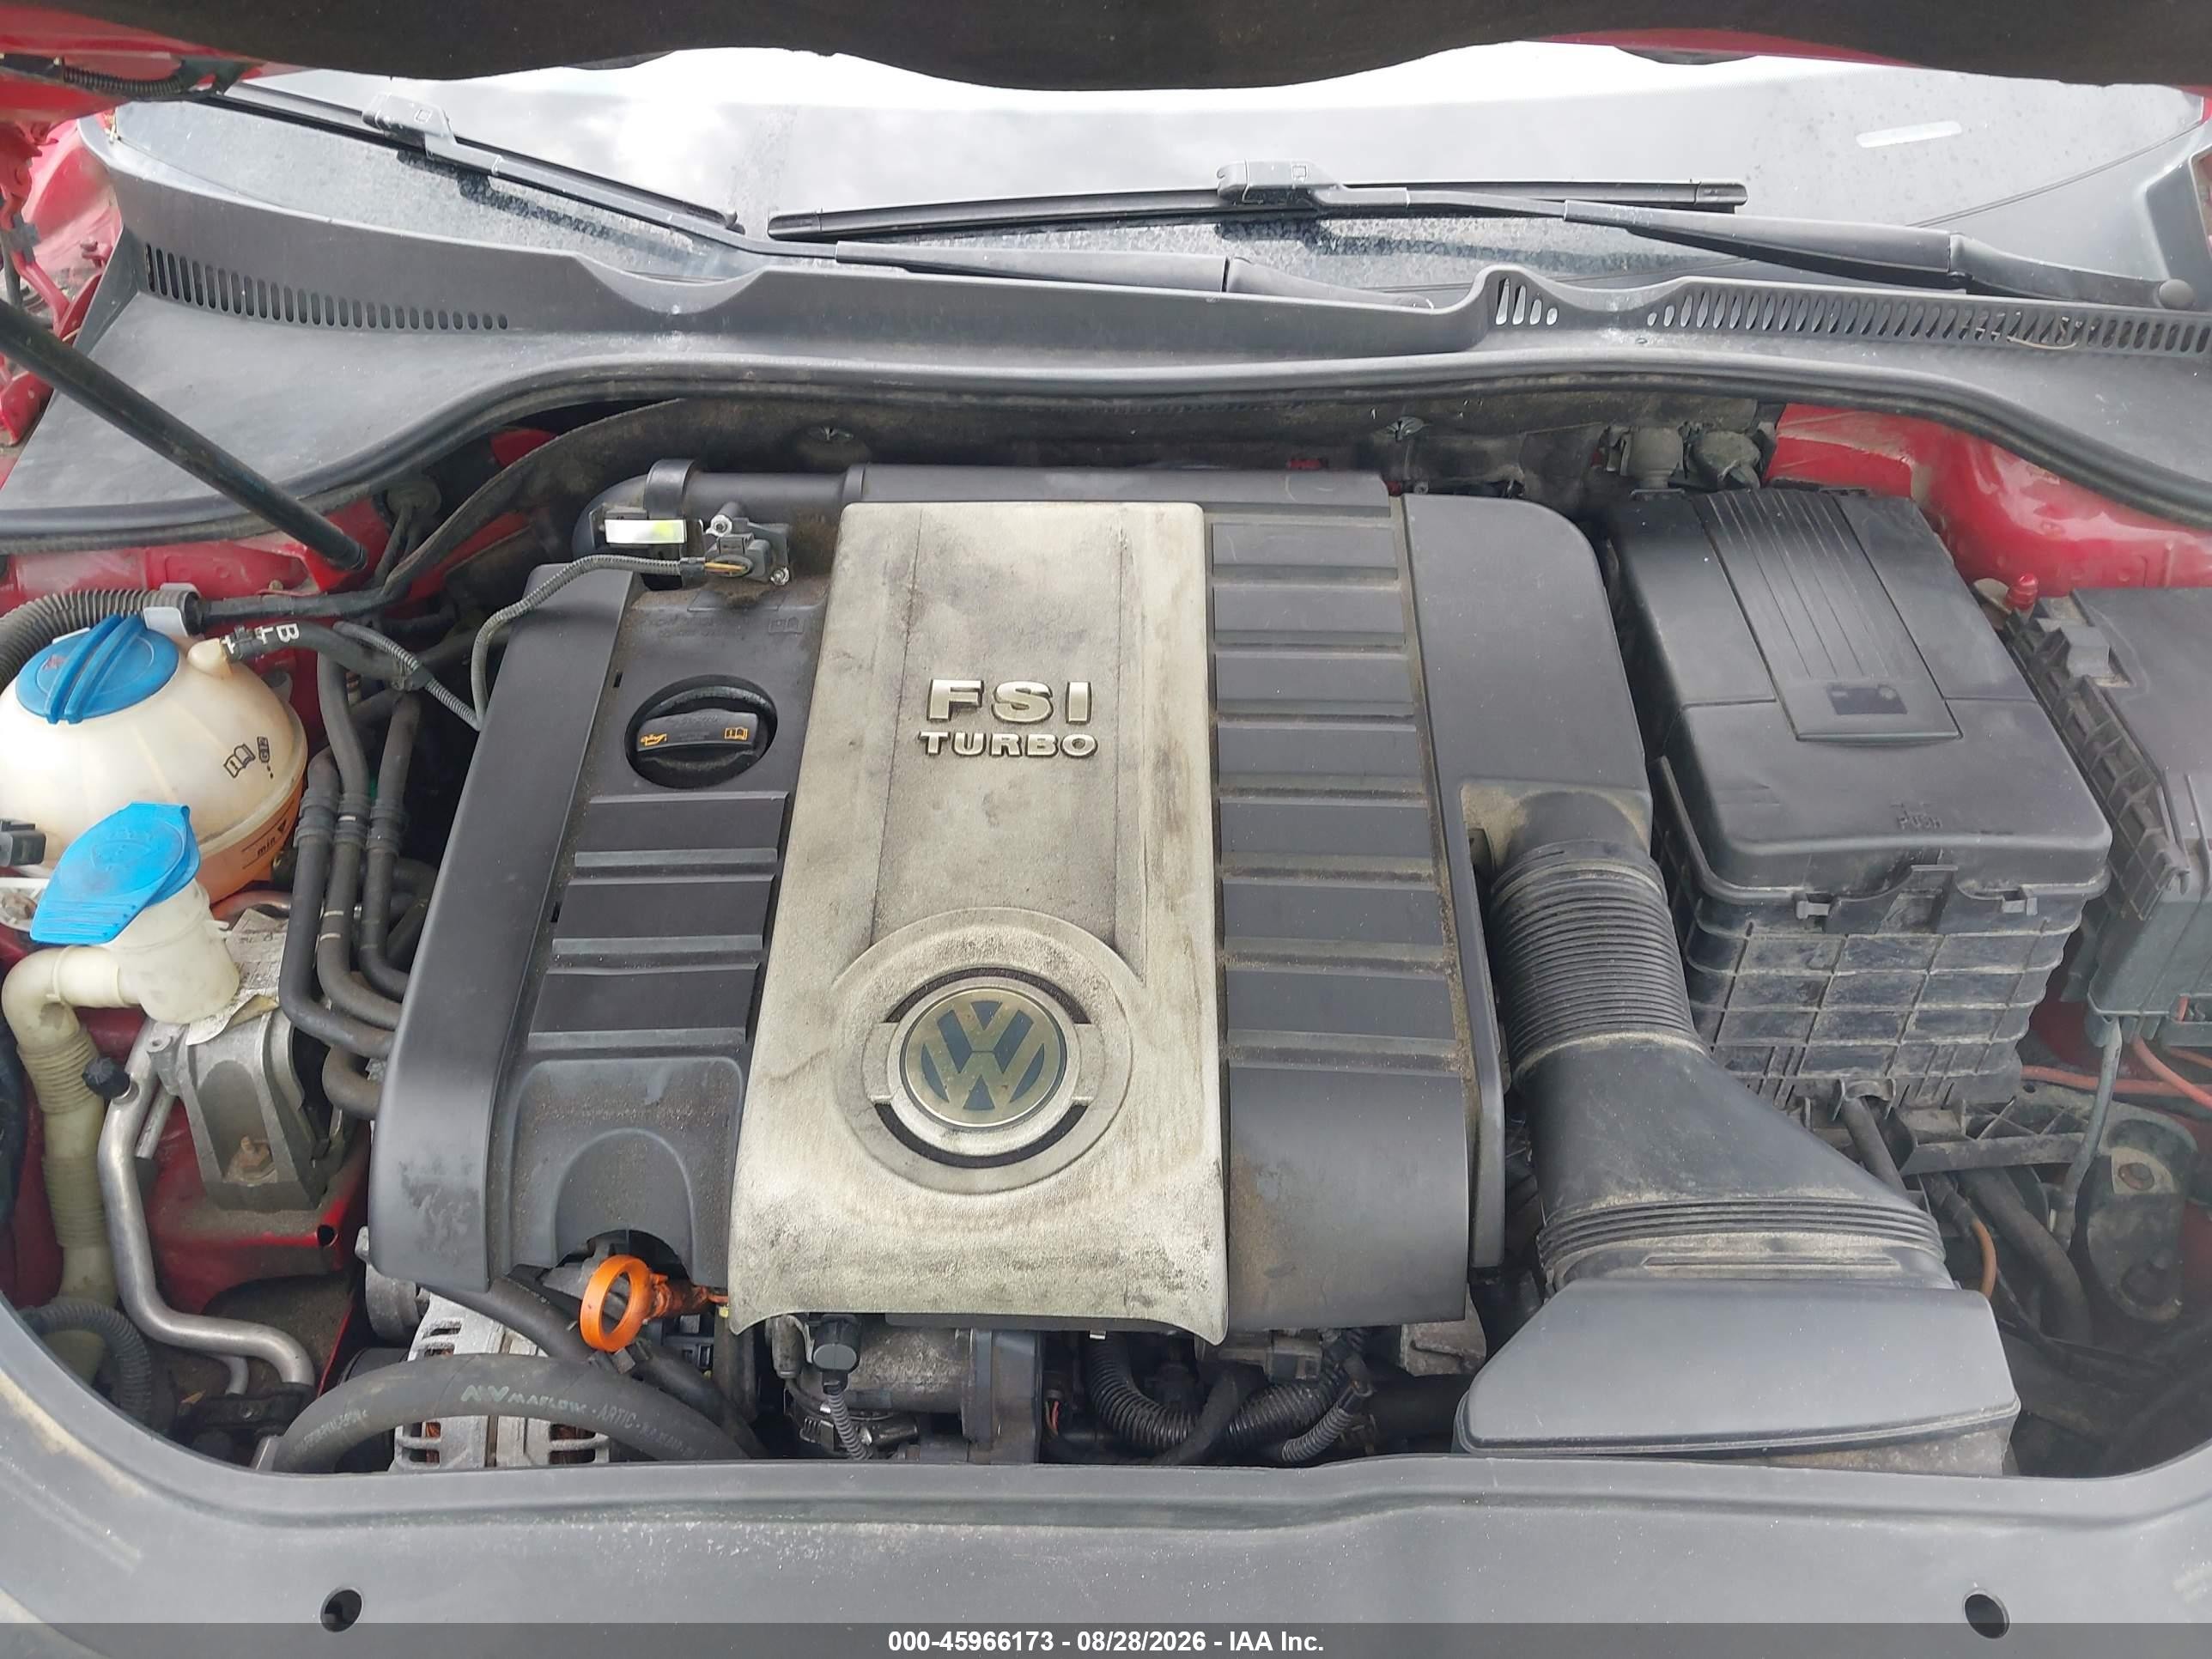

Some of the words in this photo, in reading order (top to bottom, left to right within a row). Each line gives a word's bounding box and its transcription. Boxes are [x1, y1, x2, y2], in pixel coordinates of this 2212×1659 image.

[927, 679, 1092, 724] FSI
[918, 731, 1097, 757] TURBO
[257, 836, 276, 857] min
